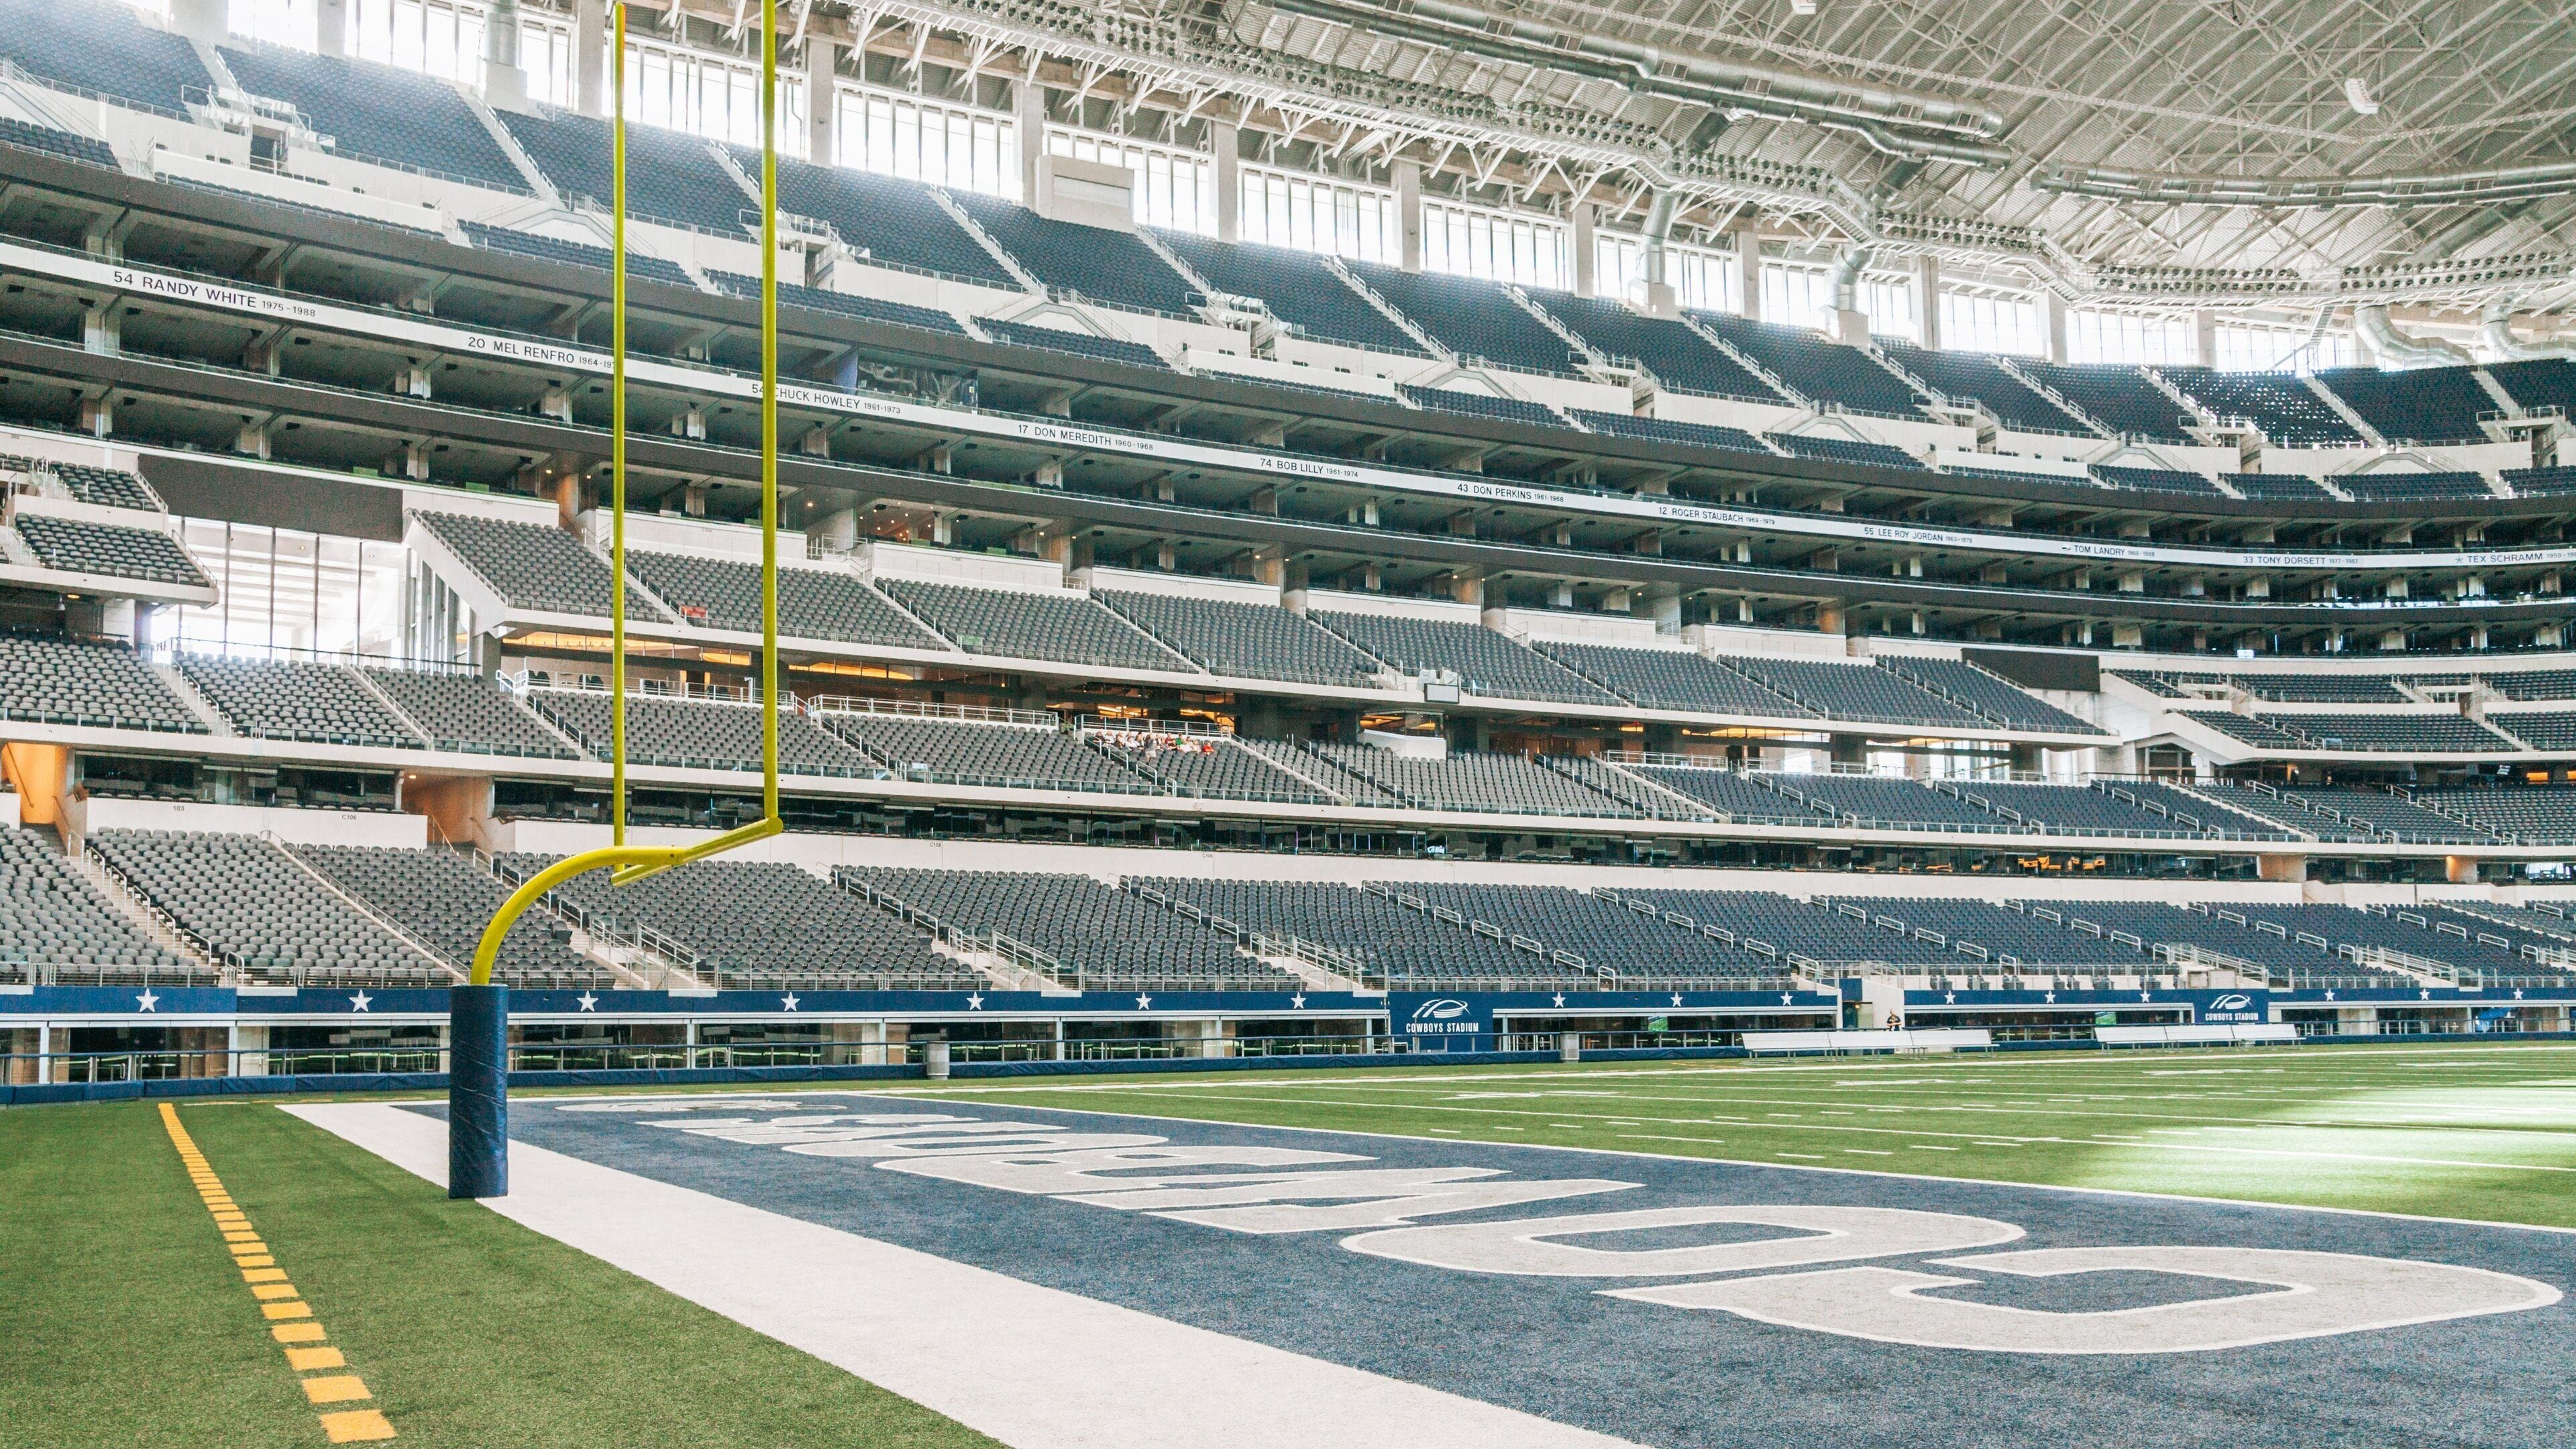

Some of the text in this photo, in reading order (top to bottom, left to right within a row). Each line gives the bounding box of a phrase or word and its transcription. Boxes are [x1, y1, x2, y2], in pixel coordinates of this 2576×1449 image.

[114, 271, 133, 284] 54
[143, 276, 198, 296] RANDY
[206, 288, 257, 307] WHITE
[468, 337, 485, 348] 20
[494, 341, 519, 355] MEL
[524, 346, 574, 364] RENFRO
[814, 393, 860, 409] HOWLEY
[864, 402, 901, 414] 1961-1973
[1018, 425, 1028, 434] 17
[1035, 427, 1056, 438] DON
[1061, 430, 1112, 446] MEREDITH
[1260, 458, 1272, 468] 74
[1277, 460, 1297, 471] BOB
[1301, 463, 1324, 474] LILLY
[1457, 484, 1468, 492] 43
[1474, 485, 1492, 495] DON
[1495, 488, 1532, 500] PERKINS
[1659, 507, 1667, 515] 12
[1672, 508, 1700, 518] ROGER
[1703, 511, 1743, 523] STAUBACH
[1864, 527, 1874, 535] 55
[1878, 528, 1892, 537] LEE
[1895, 530, 1909, 538] ROY
[1912, 532, 1943, 541] JORDAN
[2074, 545, 2091, 553] TOM
[2094, 547, 2125, 556] LANDRY
[2467, 555, 2486, 563] TEX
[2490, 553, 2543, 563] SCHRAMM
[2243, 555, 2253, 564] 33
[2257, 556, 2281, 564] TONY
[2284, 557, 2326, 565] DORSETT
[2205, 1012, 2259, 1021] COWBOYS STADIUM
[1406, 1022, 1479, 1033] COWBOYS STADIUM
[639, 1114, 2564, 1354] COWBOYS
